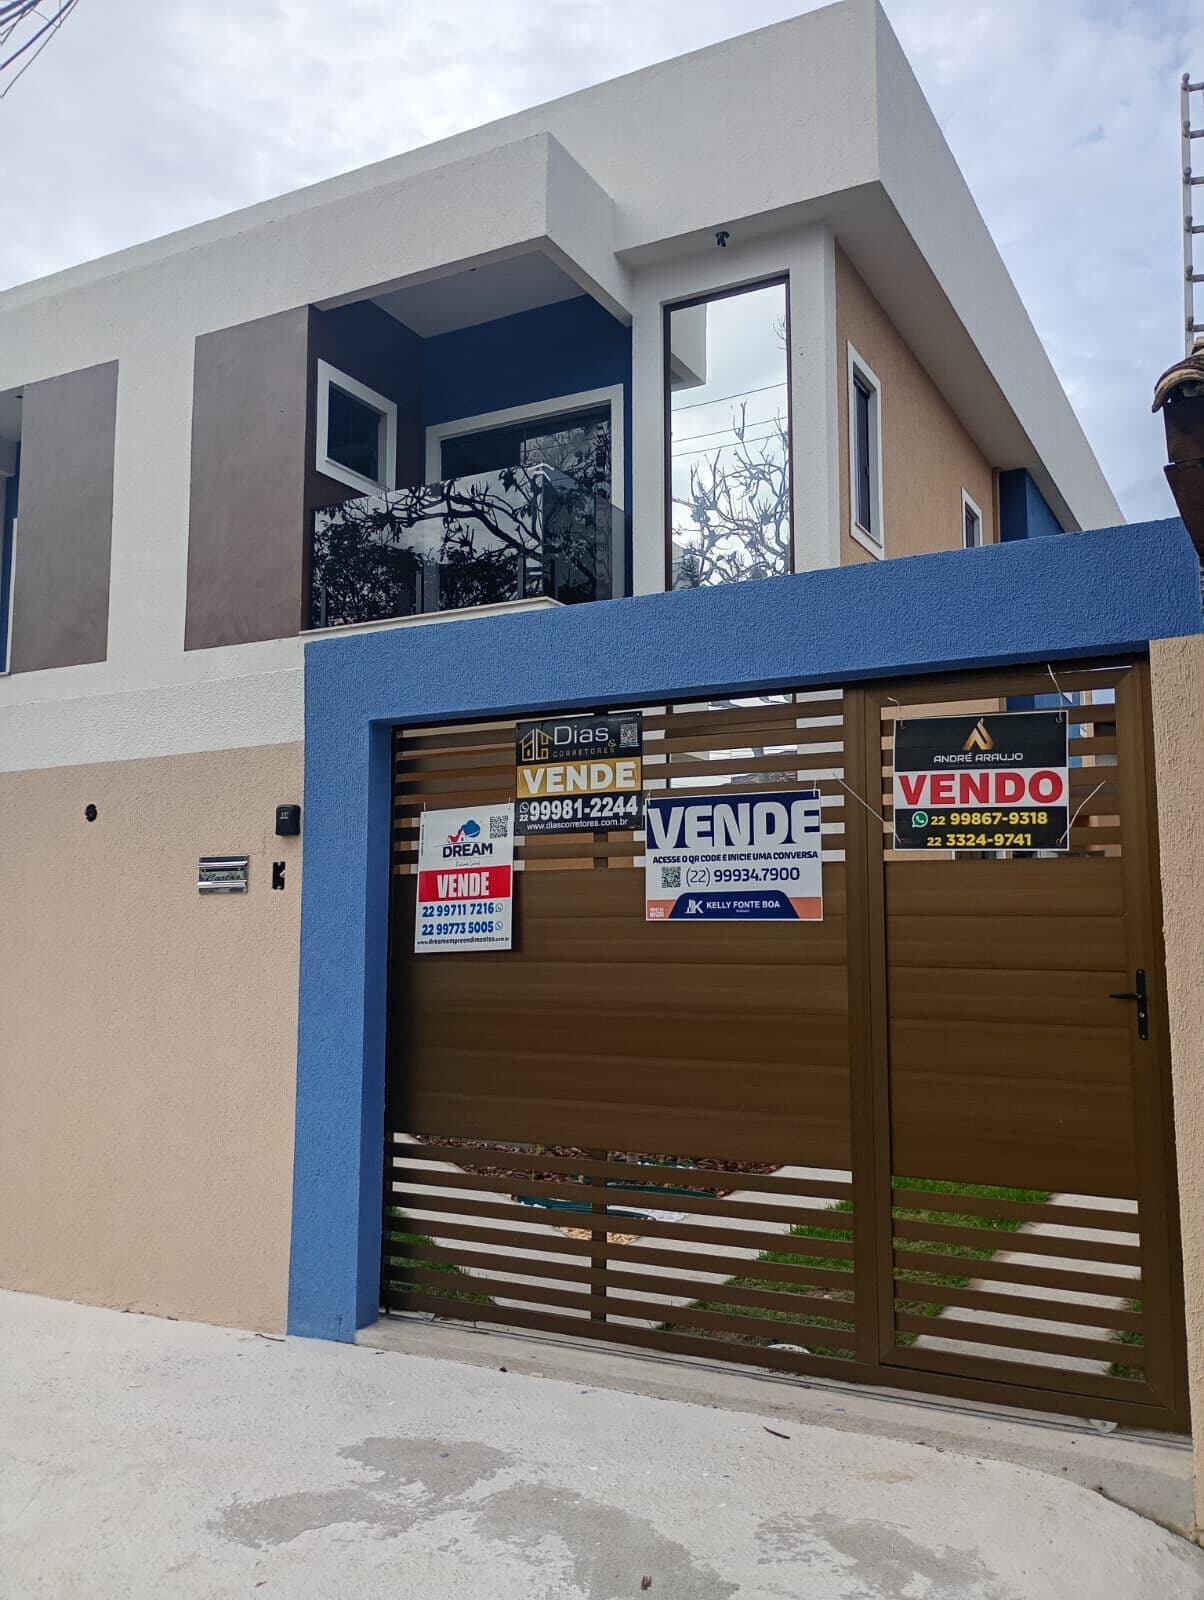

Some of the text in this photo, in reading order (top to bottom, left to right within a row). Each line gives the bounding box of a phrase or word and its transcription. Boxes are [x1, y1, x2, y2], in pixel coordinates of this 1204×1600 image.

[554, 724, 609, 745] Dias
[552, 747, 615, 758] CORRETORES
[934, 752, 1024, 764] ANDRÉ ARAUJO
[523, 761, 636, 794] VENDE
[898, 770, 1063, 805] VENDO
[519, 795, 638, 822] 22 99981-2244
[526, 817, 629, 831] www.diascorretores.com.br
[647, 800, 821, 850] VENDE
[930, 811, 1048, 826] 22 99867-9318
[926, 833, 1033, 847] 22 3324-9741
[442, 842, 493, 858] DREAM
[652, 850, 819, 864] ACESSE O QR CODE E INICIE UMA CONVERSA
[437, 871, 490, 898] VENDE
[685, 867, 800, 888] (22) 99934.7900
[422, 902, 495, 918] 22 99711 7216
[706, 902, 731, 910] KELLY
[732, 901, 760, 909] FONTE
[761, 900, 781, 909] BOA
[421, 920, 494, 936] 22 99773 5005
